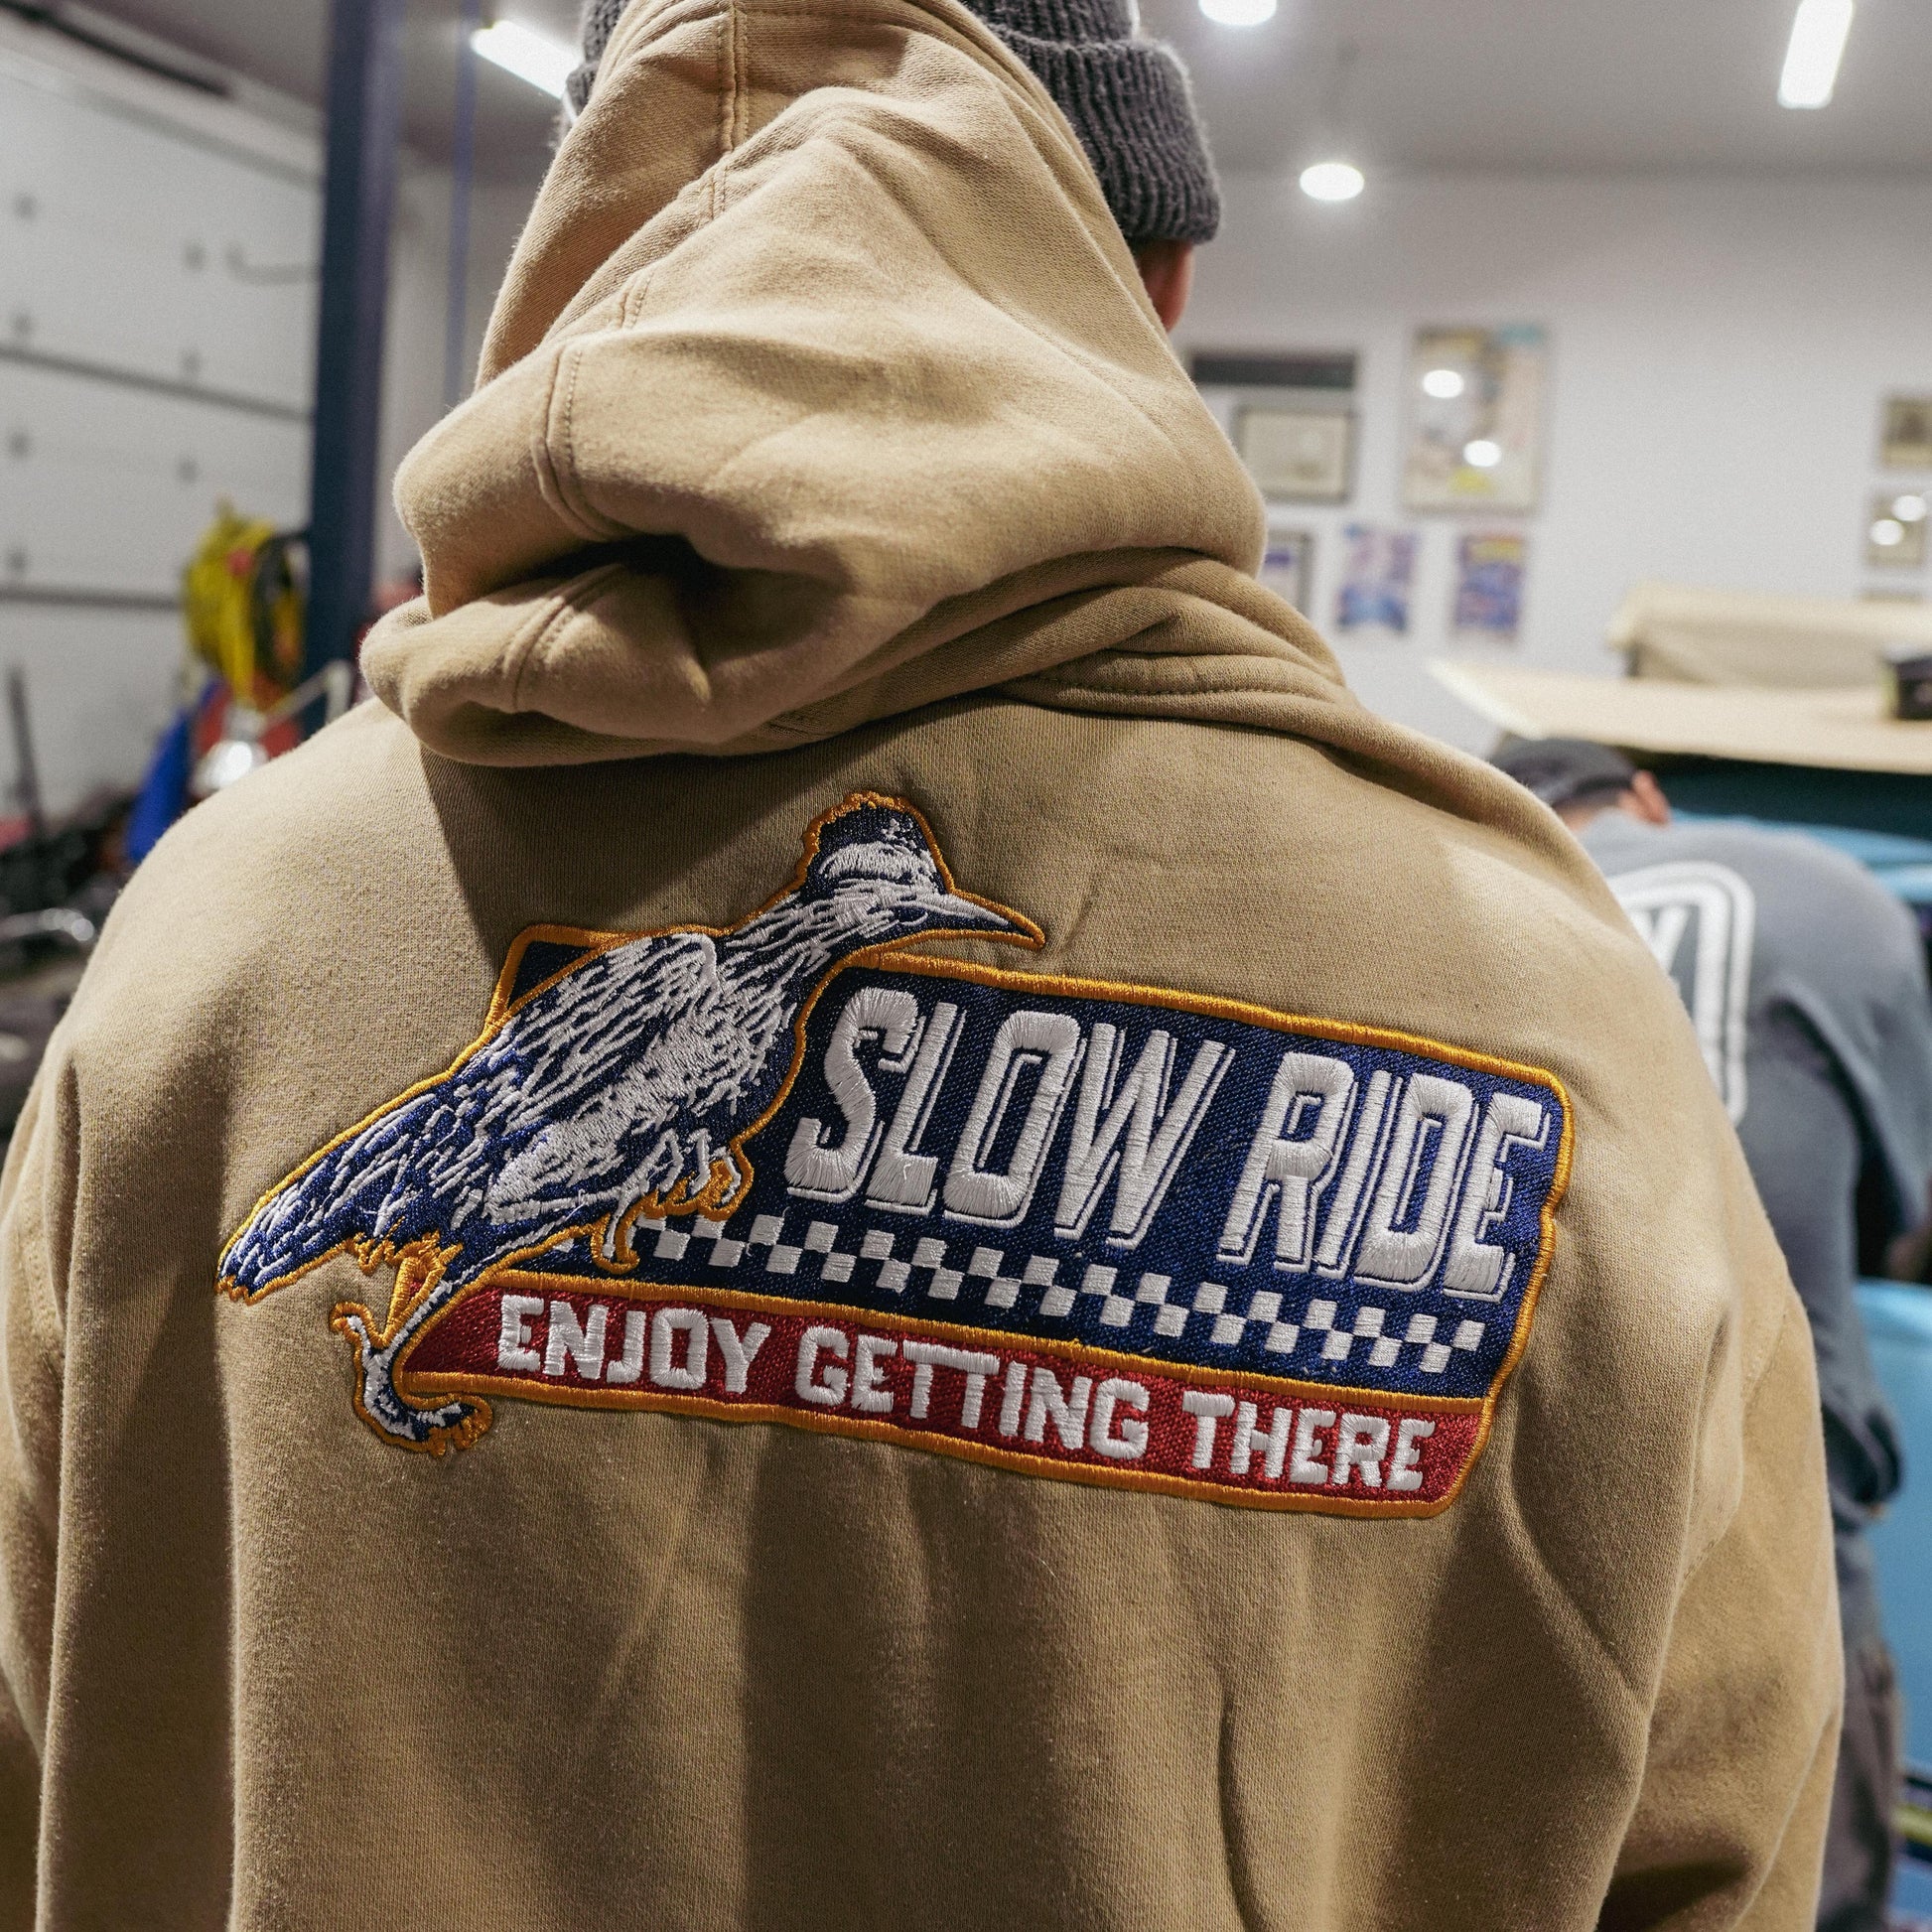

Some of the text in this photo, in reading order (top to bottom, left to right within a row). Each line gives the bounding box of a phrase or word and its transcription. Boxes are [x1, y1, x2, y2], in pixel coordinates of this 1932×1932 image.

[785, 987, 1551, 1303] SLOW RIDE
[497, 1294, 1436, 1491] ENJOY GETTING THERE
